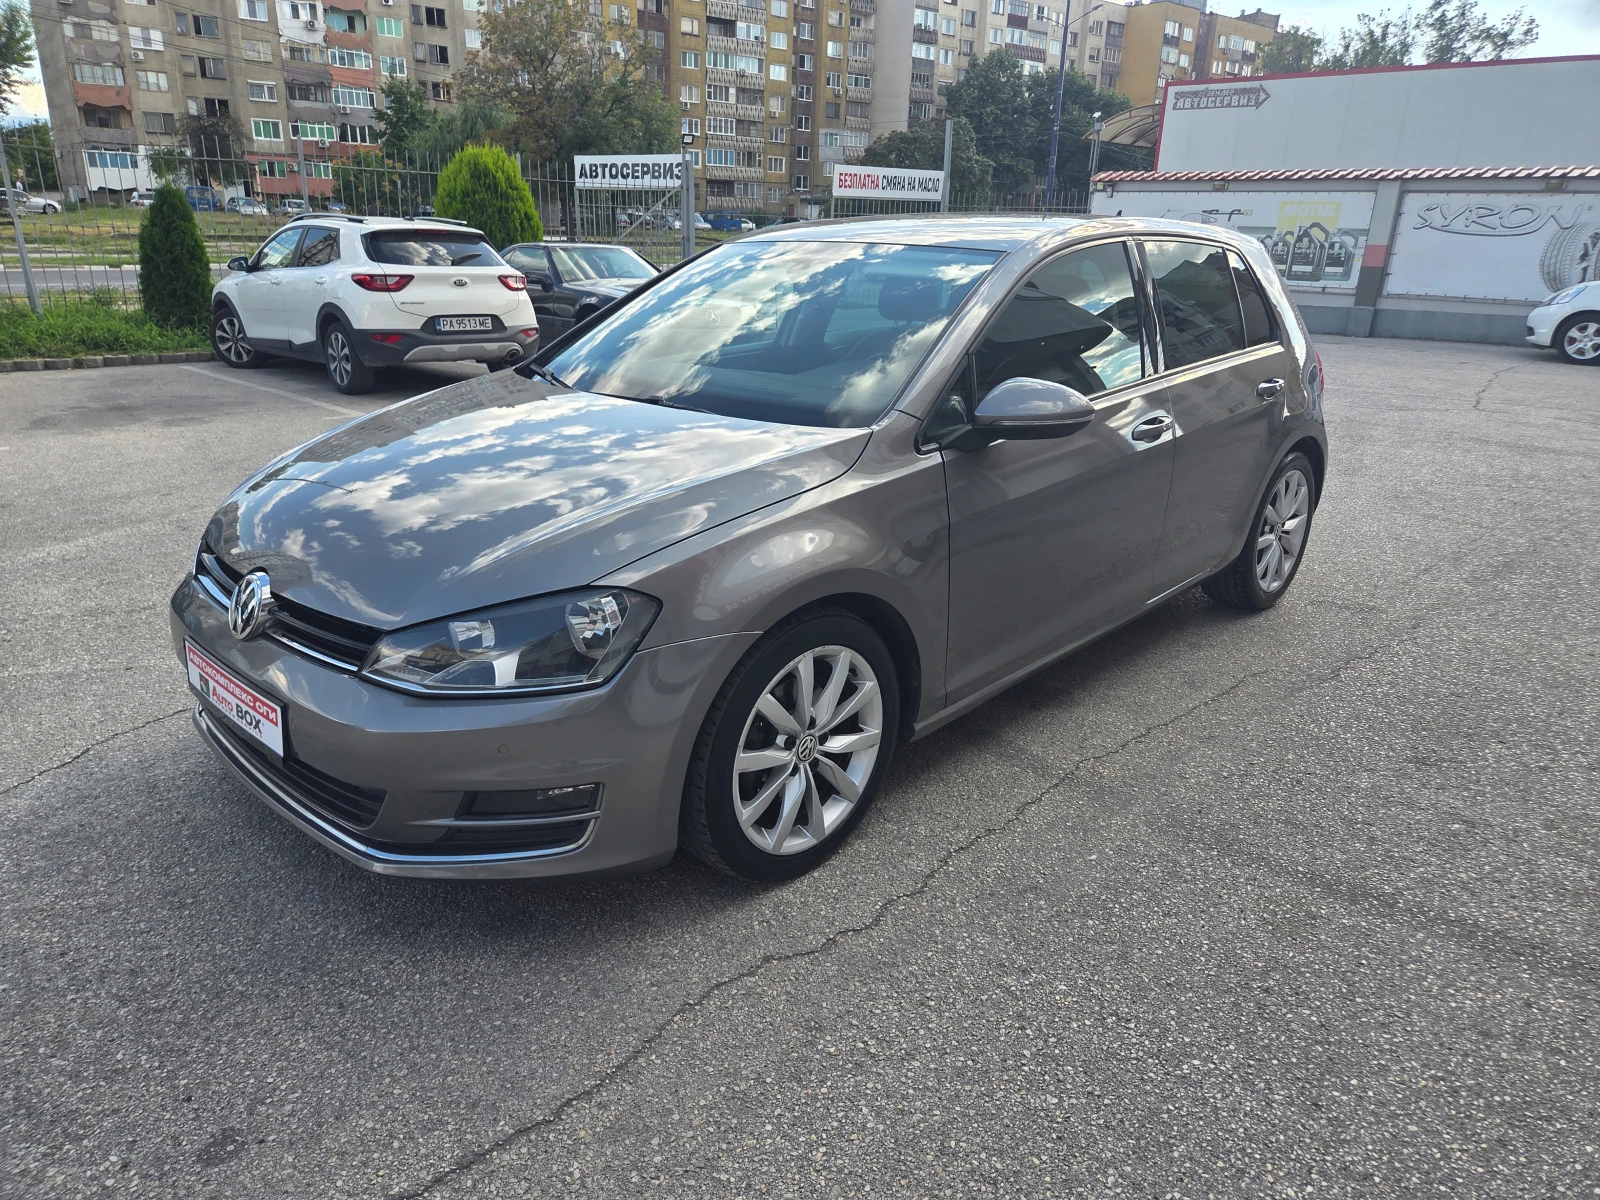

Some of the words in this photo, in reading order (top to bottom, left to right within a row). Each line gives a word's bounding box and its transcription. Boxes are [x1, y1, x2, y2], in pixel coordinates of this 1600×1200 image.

[1175, 93, 1257, 109] АВТОСЕРВИЗ
[579, 162, 683, 180] АВТОСЕРВИЗ
[838, 172, 880, 190] БЕЗПЛАТНА
[881, 174, 906, 192] СМЯНА
[907, 176, 916, 192] НА
[917, 177, 940, 193] МАСЛО
[1282, 203, 1338, 217] MOTUL
[1413, 203, 1584, 231] SYRON
[442, 319, 454, 329] PA
[456, 318, 477, 329] 9513
[479, 318, 491, 329] ME
[189, 651, 254, 707] АВТОКОМПЛЕКС
[255, 703, 277, 723] ОГИ
[235, 702, 263, 735] BOX
